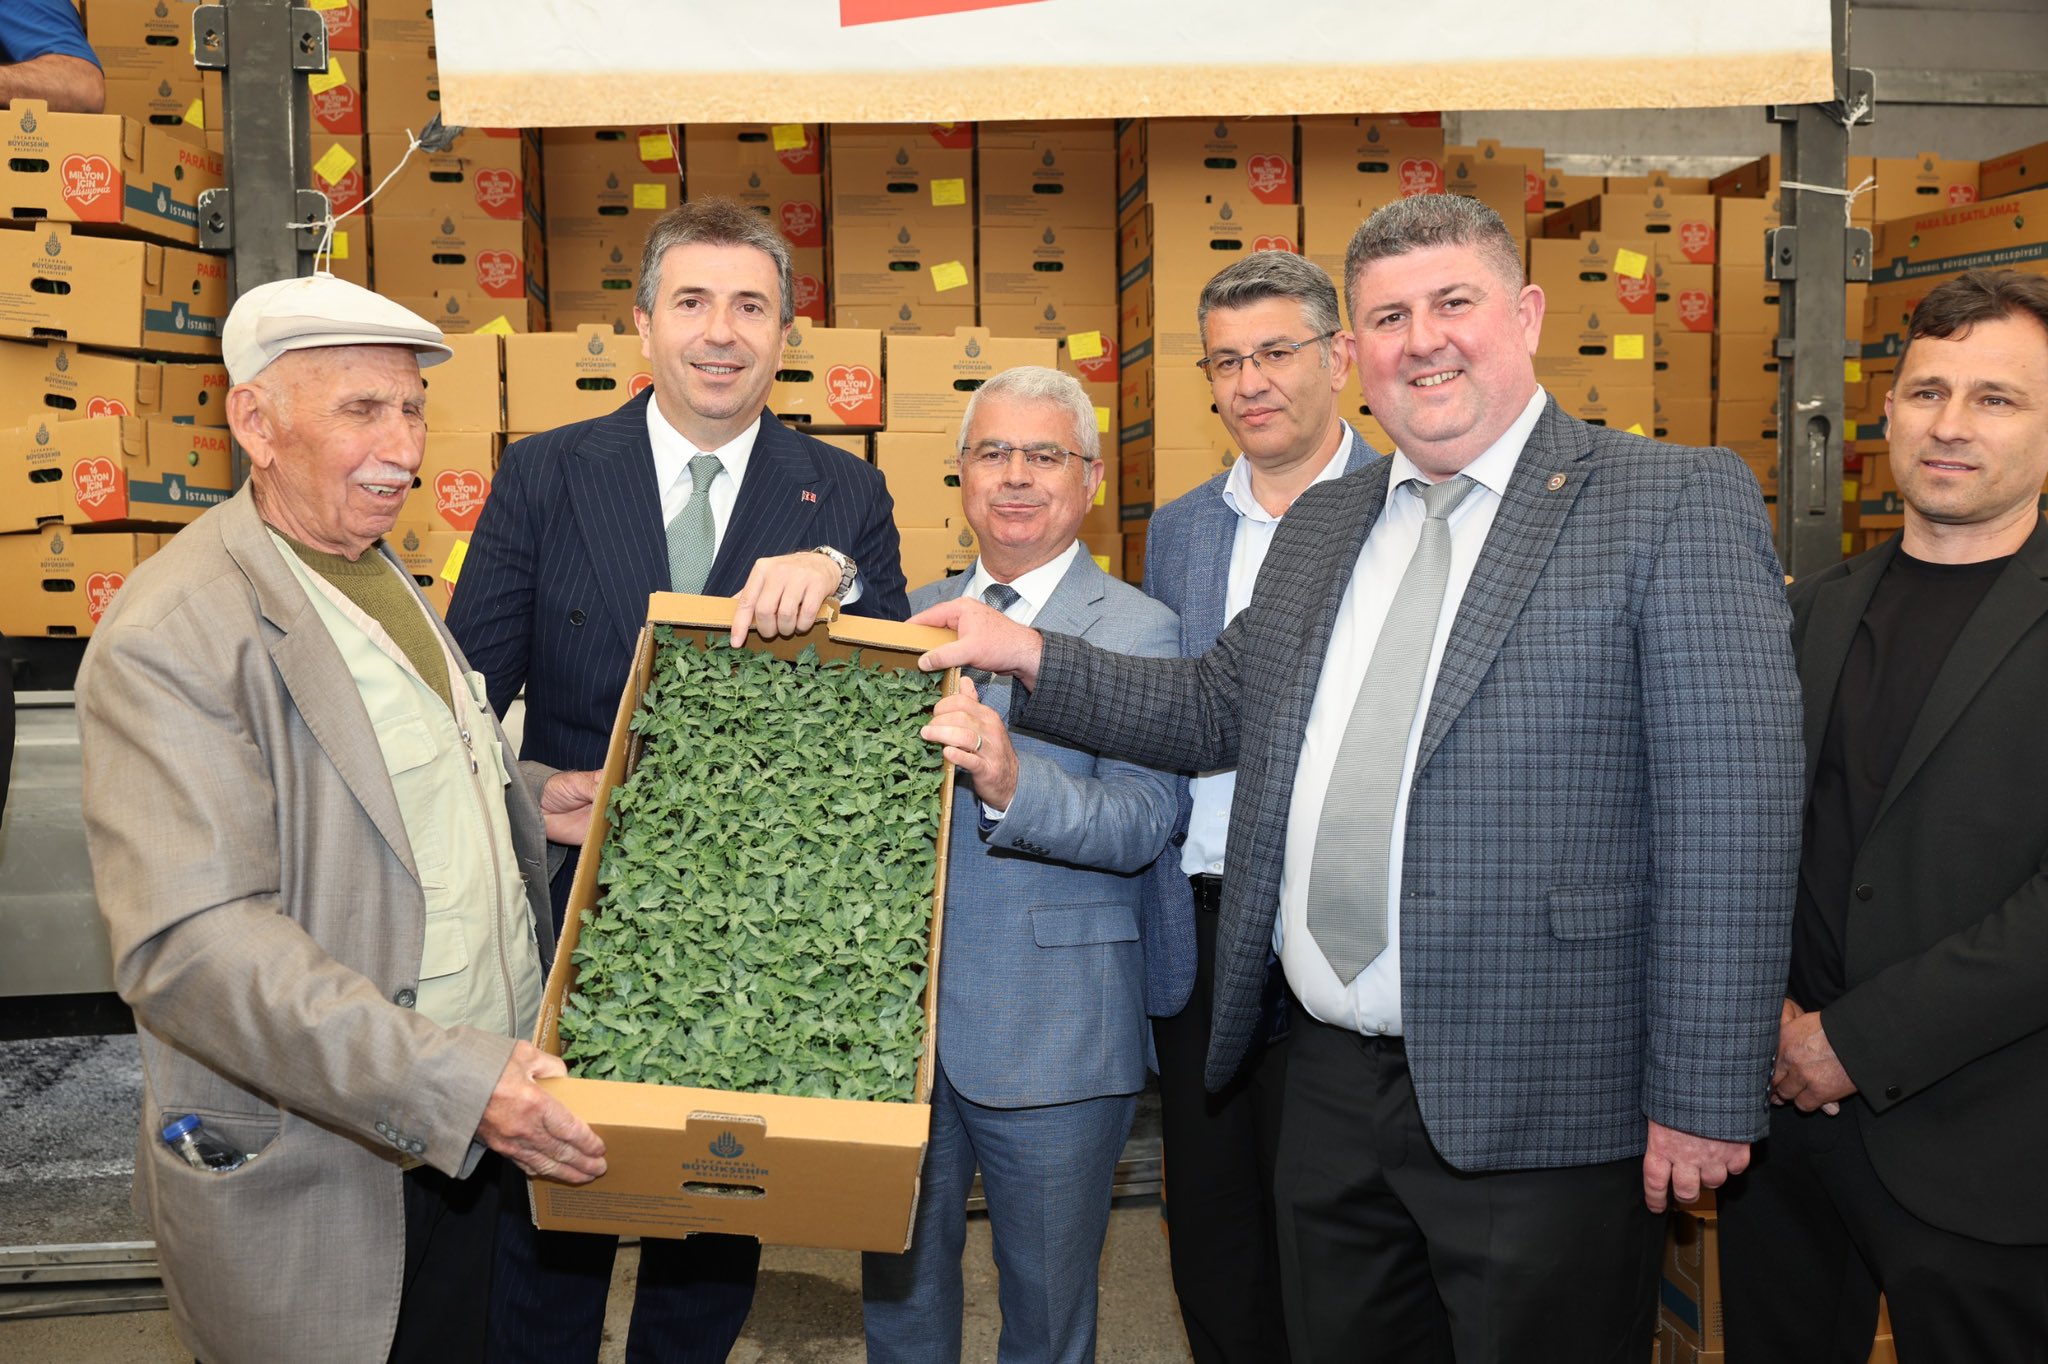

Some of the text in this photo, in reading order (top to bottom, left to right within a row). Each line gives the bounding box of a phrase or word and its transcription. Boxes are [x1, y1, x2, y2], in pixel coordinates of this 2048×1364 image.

[8, 140, 49, 148] BÜYÜKŞEHİR
[179, 149, 223, 177] PARA İLE
[69, 171, 104, 180] MİLYON
[78, 179, 96, 188] İÇİN
[1959, 202, 2020, 222] SATILAMAZ
[1994, 246, 2042, 262] BELEDİYESİ
[197, 262, 222, 279] PARA
[833, 380, 867, 388] MİLYON
[841, 387, 859, 396] İÇİN
[103, 406, 112, 415] 16
[193, 435, 226, 453] PARA
[90, 466, 98, 474] 16
[80, 472, 109, 483] MİLYON
[455, 478, 464, 486] 16
[87, 480, 103, 491] İÇİN
[442, 485, 477, 493] MİLYON
[682, 1162, 769, 1176] BÜYÜKŞEHİR
